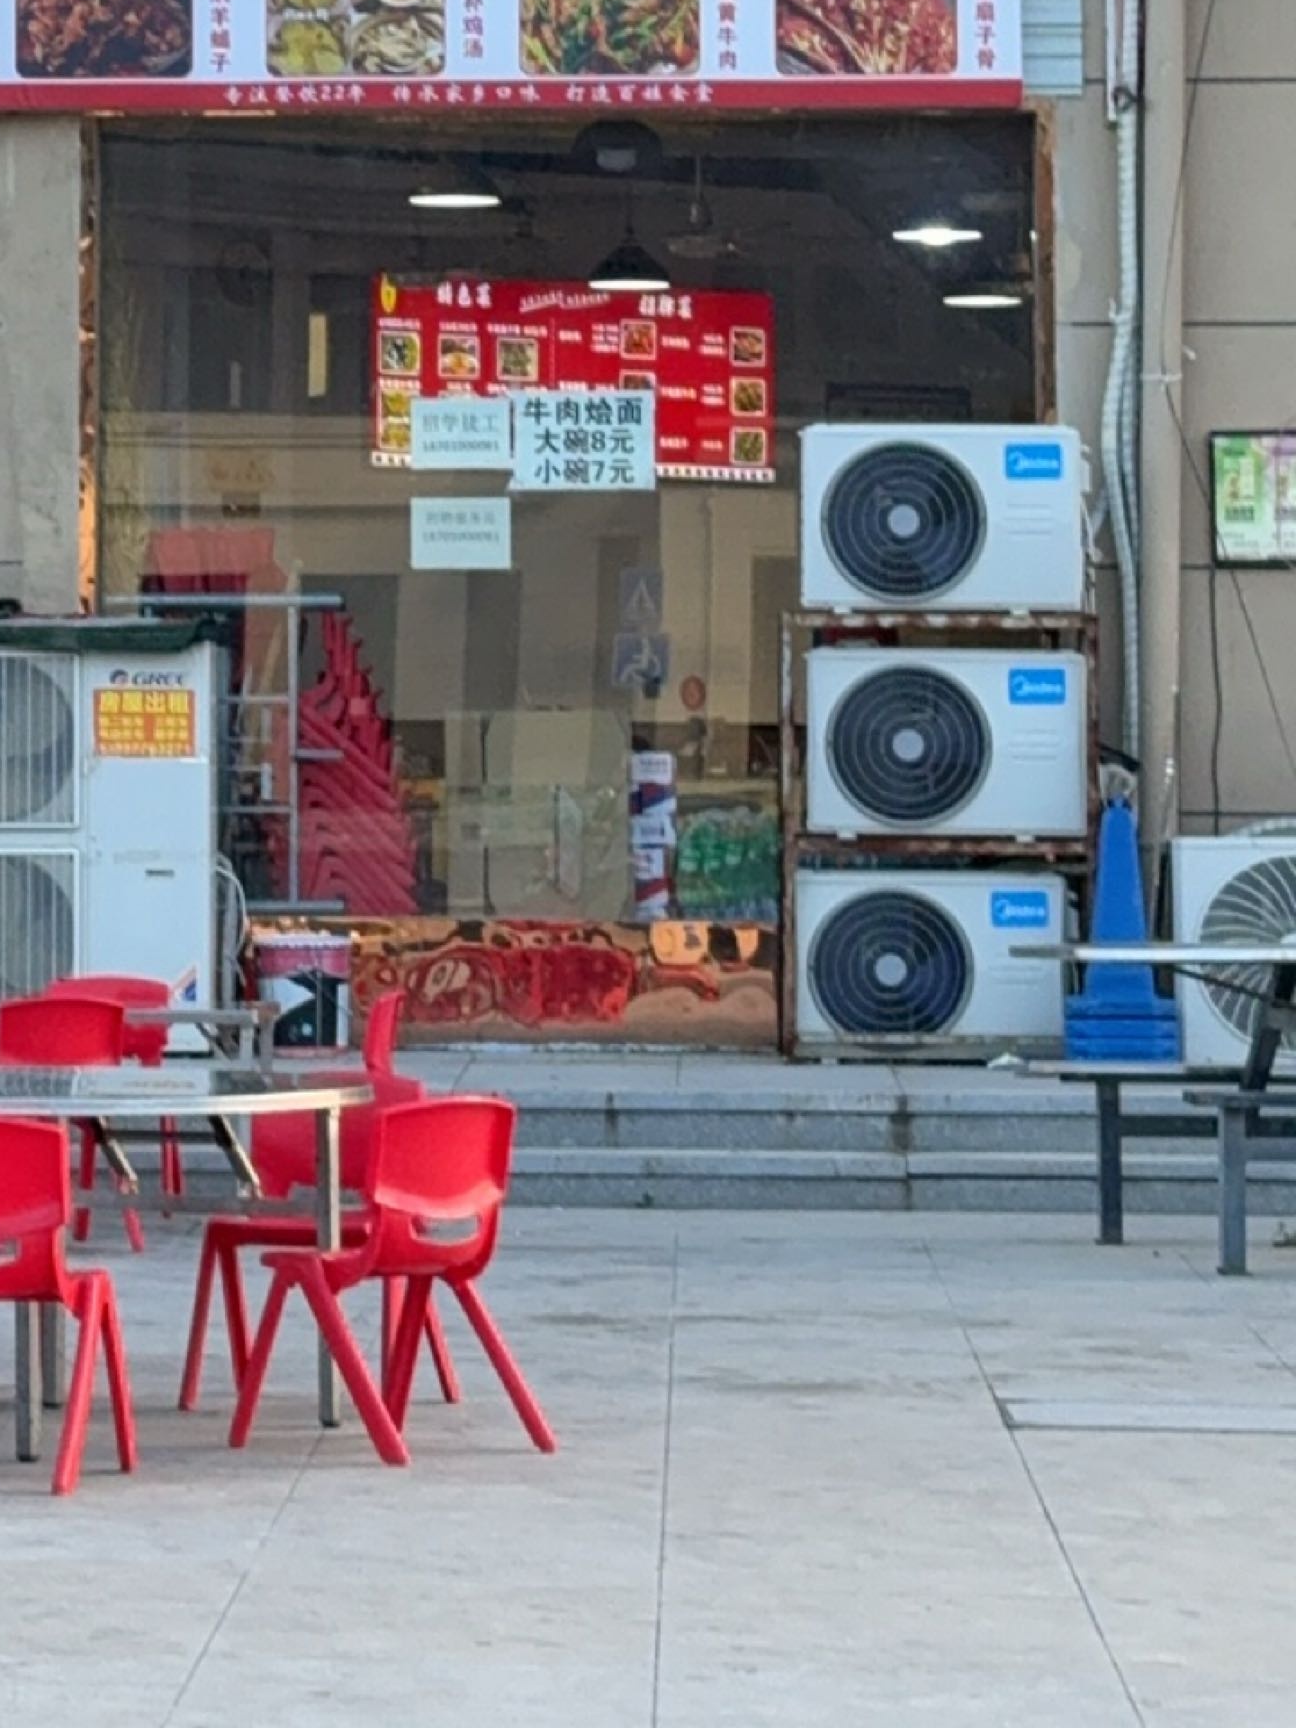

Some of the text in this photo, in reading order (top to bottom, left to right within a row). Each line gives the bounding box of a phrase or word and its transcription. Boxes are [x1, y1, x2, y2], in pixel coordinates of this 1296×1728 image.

[522, 396, 643, 426] 牛肉烩面
[533, 429, 635, 454] 大碗8元
[533, 459, 635, 485] 小碗7元
